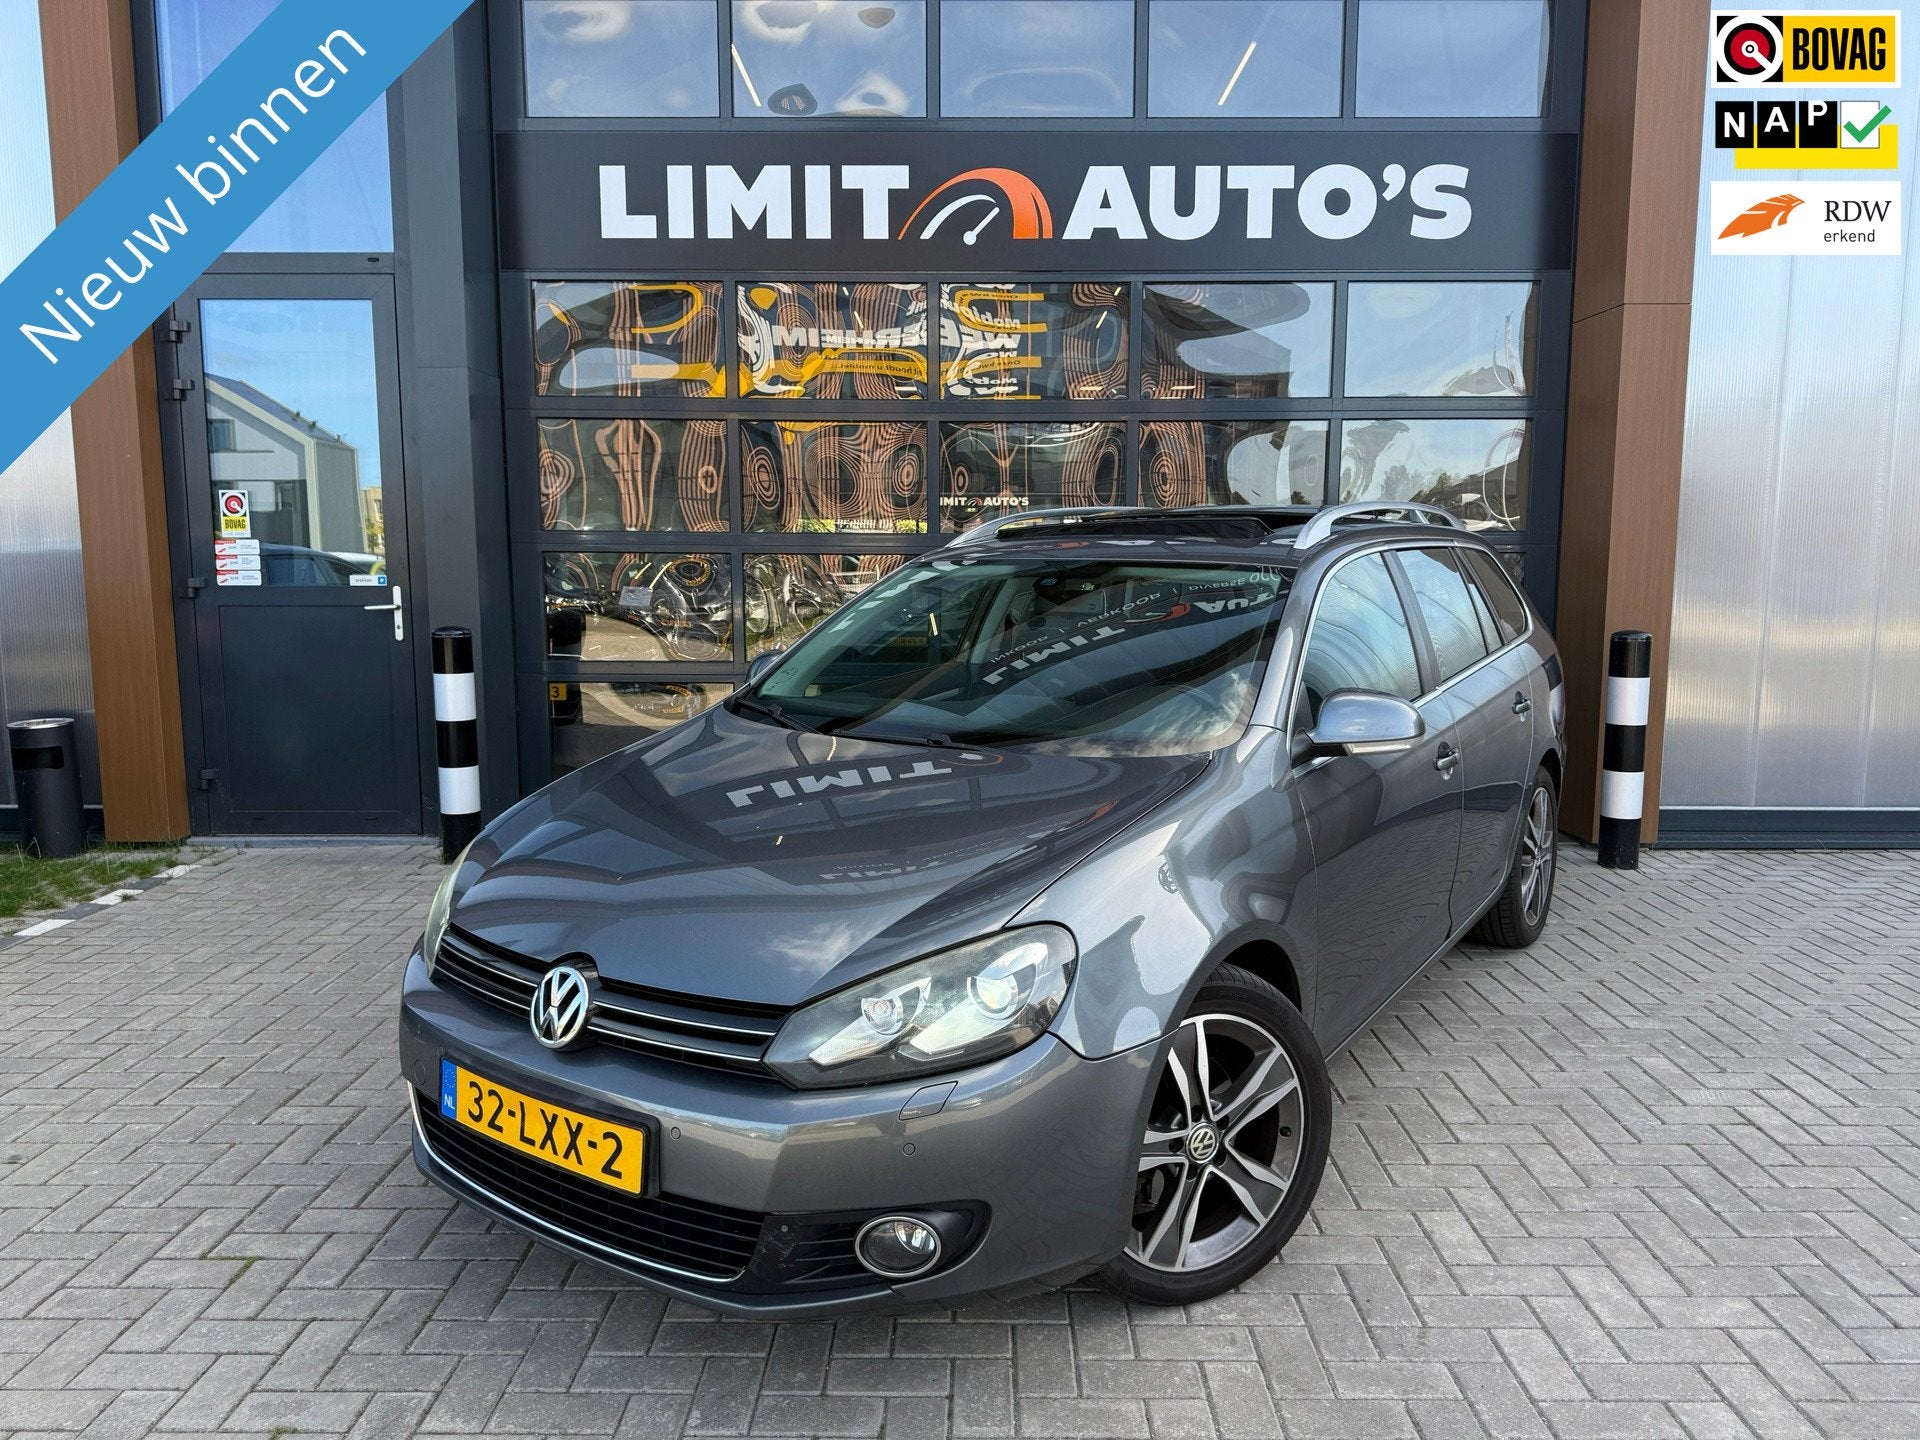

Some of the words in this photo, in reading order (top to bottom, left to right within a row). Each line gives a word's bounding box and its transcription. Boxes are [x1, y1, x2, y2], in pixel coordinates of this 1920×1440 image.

[600, 165, 909, 239] LIMIT
[1062, 163, 1472, 240] AUTO'S
[940, 496, 967, 506] IMIT
[983, 496, 1029, 506] AUTO'S
[224, 519, 246, 530] BOVAG
[444, 1093, 455, 1110] NL
[467, 1080, 623, 1180] 32-LXX-2
